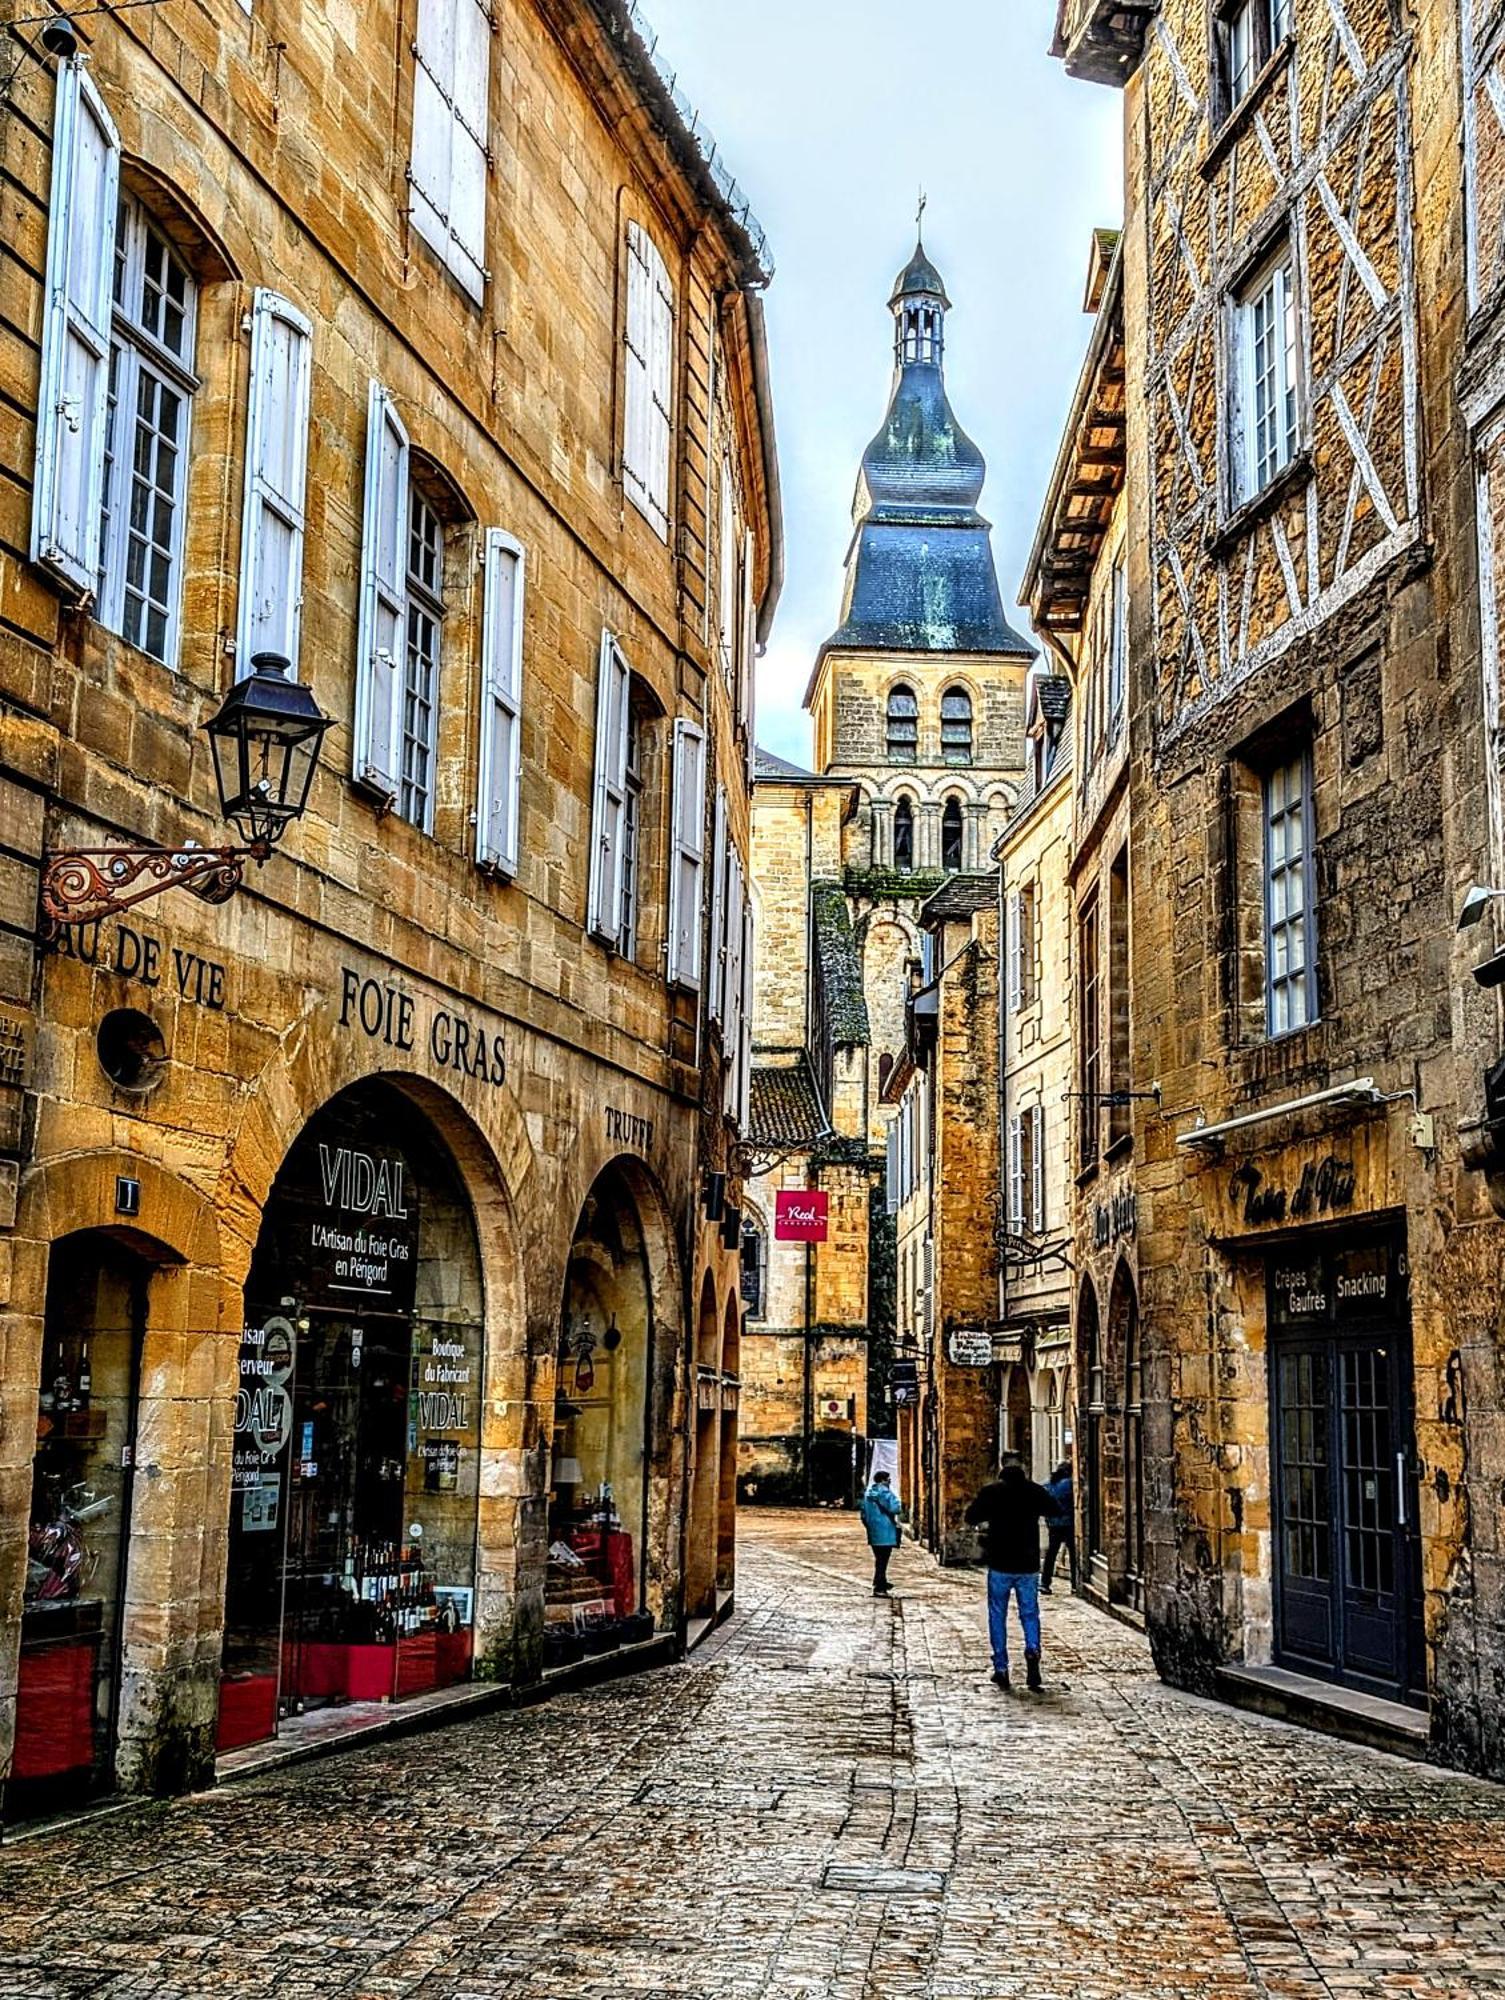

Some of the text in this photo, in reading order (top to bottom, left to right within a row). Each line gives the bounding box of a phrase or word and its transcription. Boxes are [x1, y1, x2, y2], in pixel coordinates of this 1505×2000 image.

[114, 924, 161, 986] DE
[172, 948, 226, 1010] VIE
[338, 966, 506, 1087] FOIE GRAS
[319, 1143, 408, 1220] VIDAL
[311, 1224, 409, 1260] L'Artisan du Foie Gras
[335, 1256, 388, 1286] en Périgord
[1275, 1267, 1307, 1293] Crêpes
[1337, 1271, 1387, 1299] Snacking
[1289, 1290, 1326, 1313] Gaufres
[432, 1338, 465, 1363] Boutique
[239, 1359, 275, 1376] erveur
[424, 1362, 471, 1383] du Fabricant
[418, 1391, 468, 1430] VIDAL
[245, 1450, 260, 1465] Foie
[261, 1450, 276, 1465] Grs
